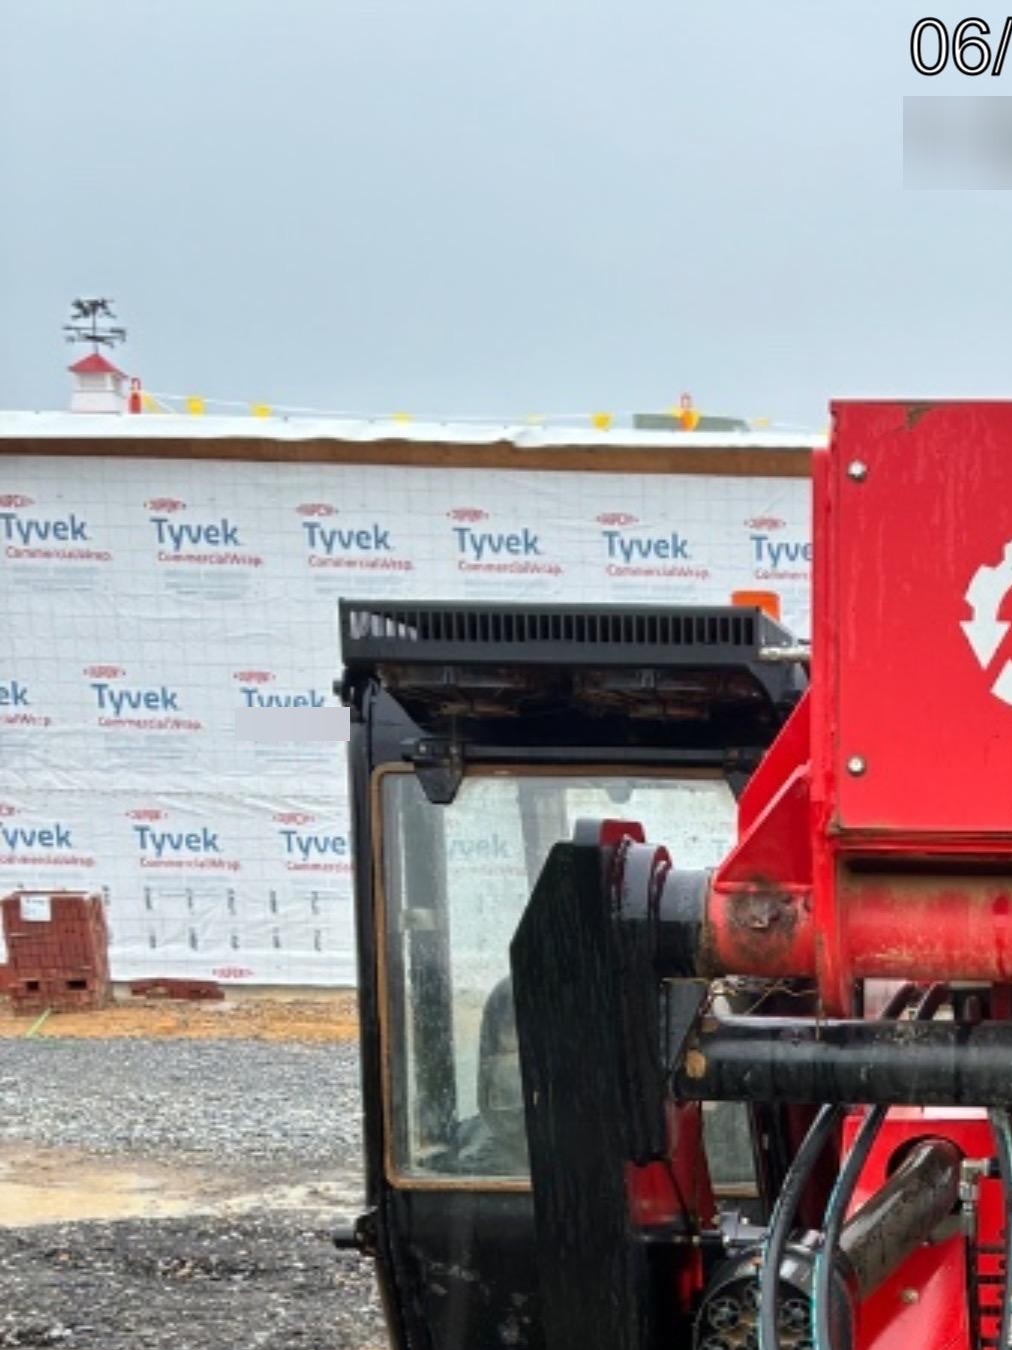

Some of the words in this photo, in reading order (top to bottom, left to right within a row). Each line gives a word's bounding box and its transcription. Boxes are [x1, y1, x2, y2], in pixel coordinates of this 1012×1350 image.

[0, 512, 88, 546] Tyvek
[150, 517, 239, 552] Tyvek
[302, 522, 391, 554] Tyvek
[452, 527, 541, 560] Tyvek
[602, 530, 688, 563] Tyvek
[750, 534, 813, 568] Tyve
[90, 683, 179, 715] Tyvek
[0, 822, 72, 851] yvek
[133, 824, 220, 857] Tyvek
[279, 830, 350, 861] Tyve
